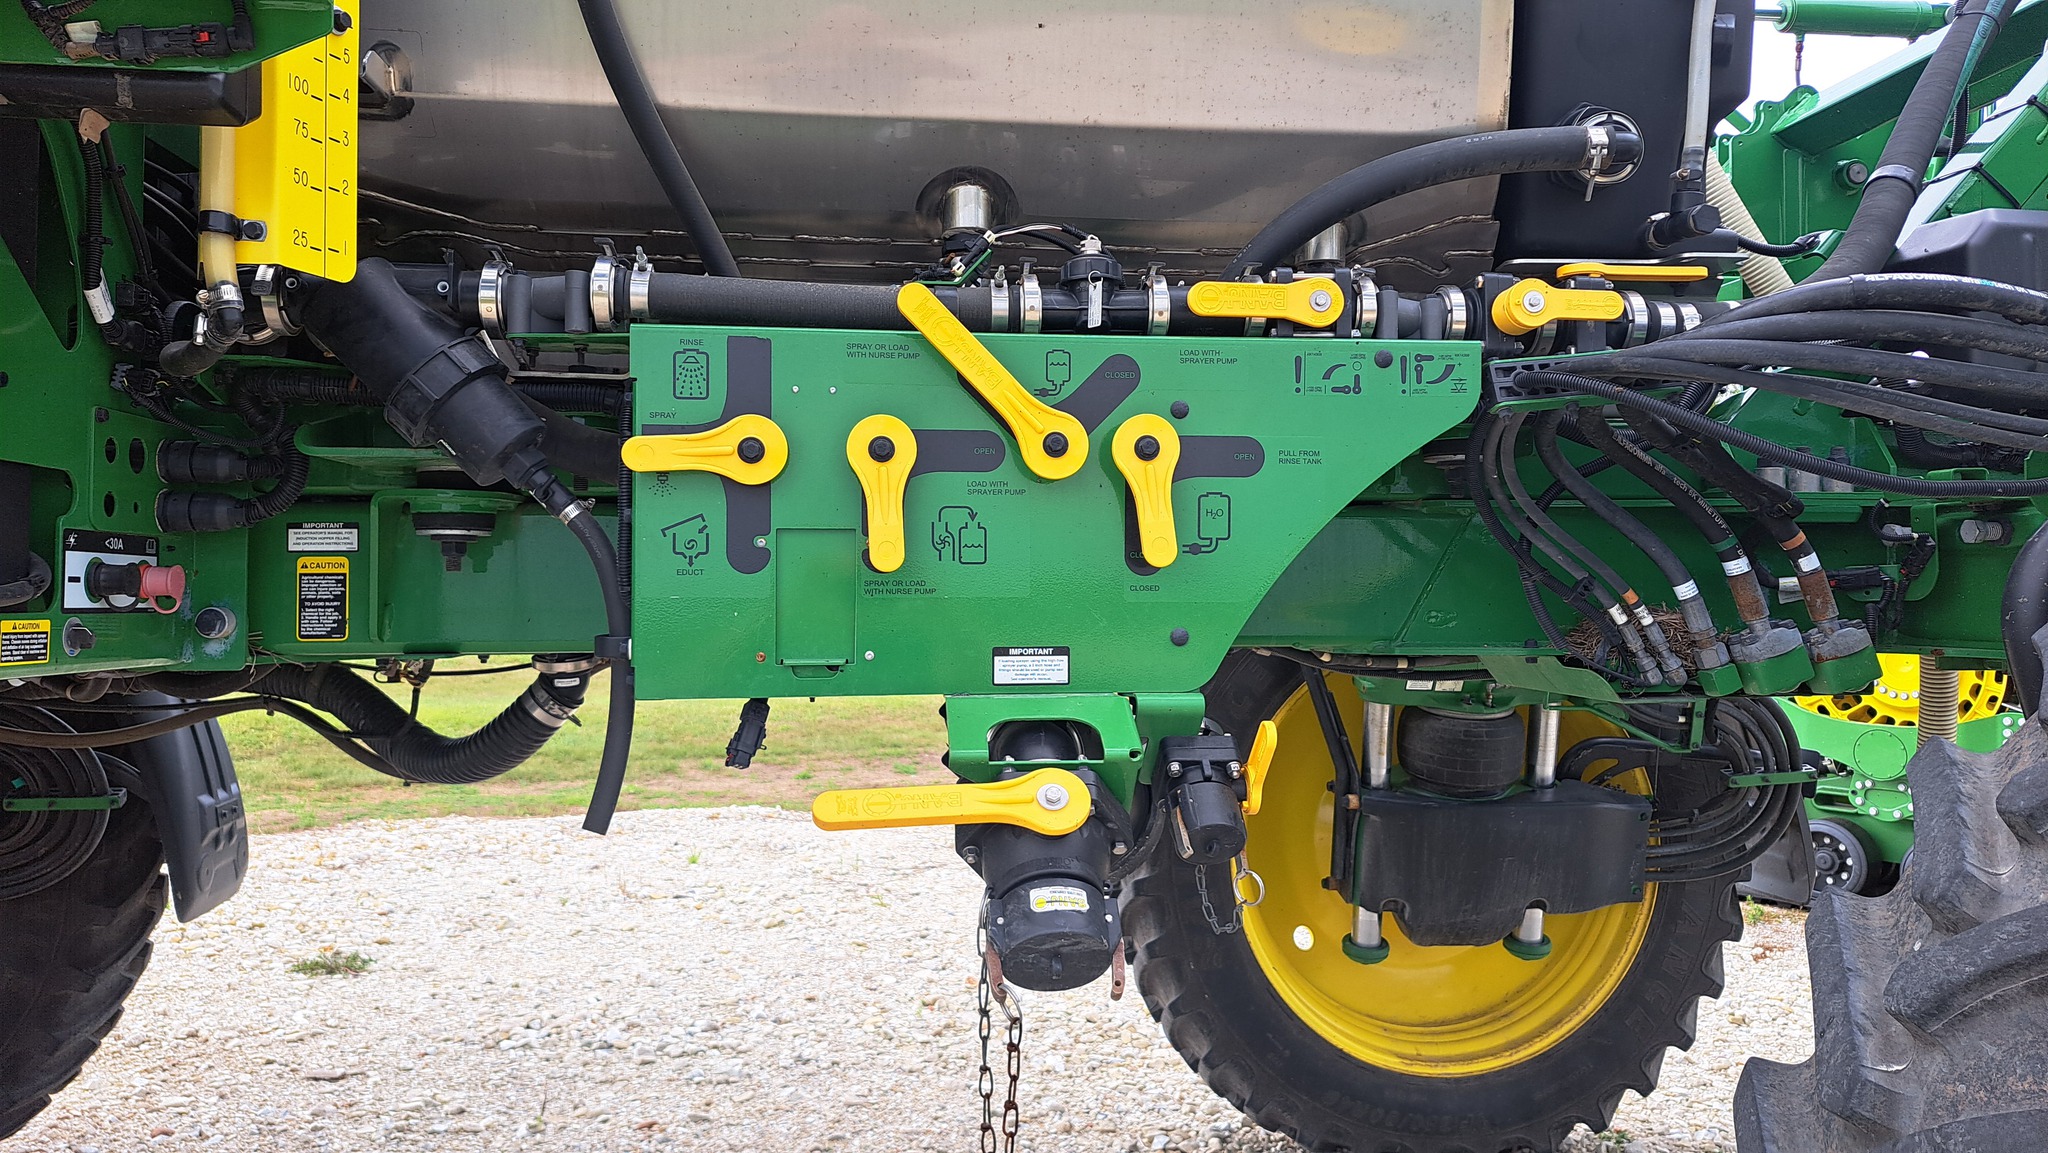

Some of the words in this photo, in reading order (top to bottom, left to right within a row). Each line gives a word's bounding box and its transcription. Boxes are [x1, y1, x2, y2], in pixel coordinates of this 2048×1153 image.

[343, 48, 350, 64] 5
[288, 72, 308, 95] 100
[343, 88, 350, 104] 4
[294, 118, 308, 138] 75
[342, 131, 349, 146] 3
[293, 168, 308, 187] 50
[342, 180, 349, 196] 2
[293, 229, 308, 248] 25
[1865, 273, 1958, 282] ALFAGOMMA
[105, 538, 124, 550] <30A
